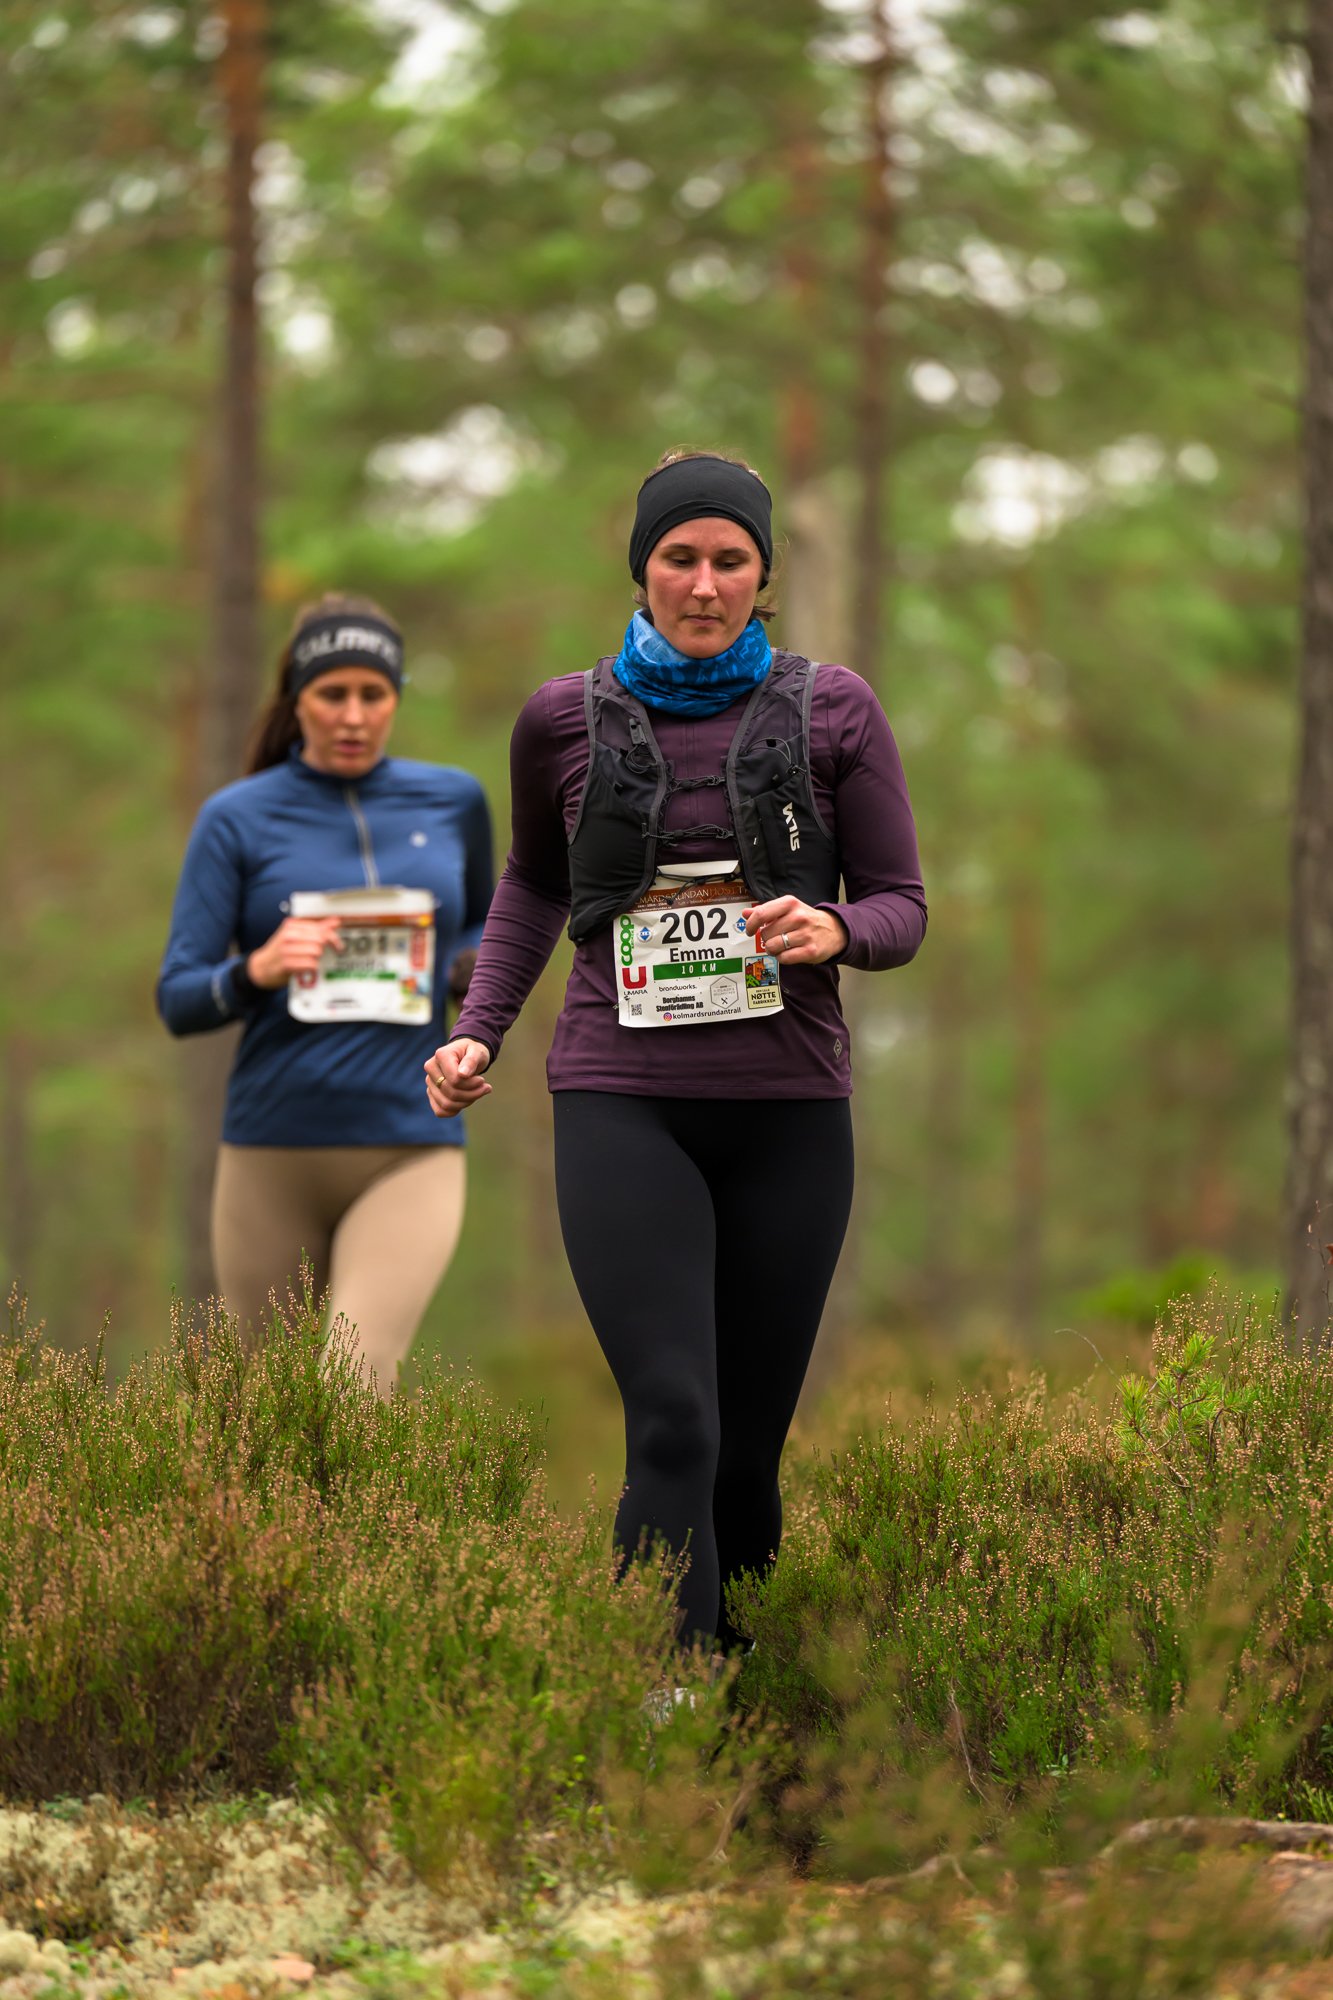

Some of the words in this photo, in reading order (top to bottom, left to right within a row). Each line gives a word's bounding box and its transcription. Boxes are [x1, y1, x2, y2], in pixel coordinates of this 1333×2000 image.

[782, 801, 801, 852] SILVA
[660, 907, 729, 944] 202
[620, 914, 635, 966] coop
[670, 947, 725, 962] Emma
[681, 964, 694, 975] 10
[702, 962, 717, 973] KM
[751, 991, 777, 1001] NØTTE
[672, 1007, 742, 1020] kolmardsrundantrail
